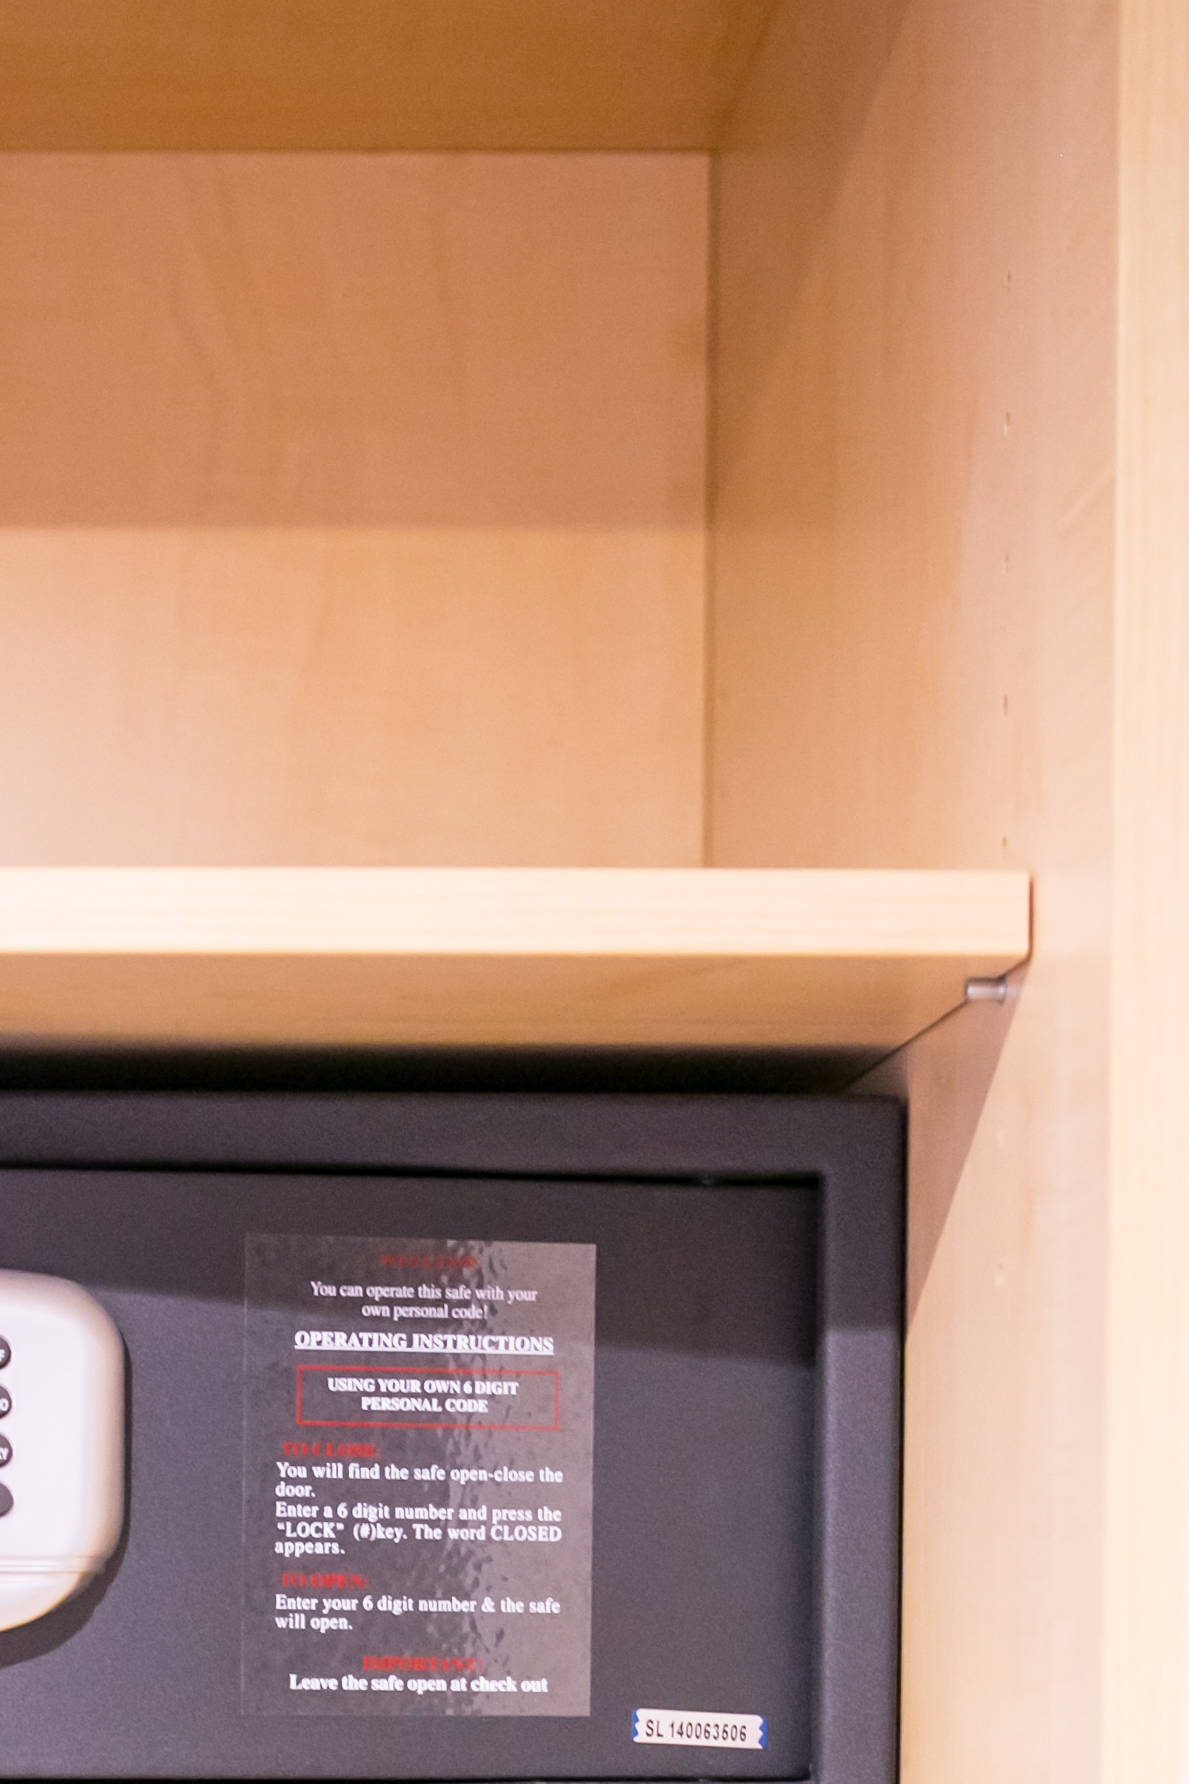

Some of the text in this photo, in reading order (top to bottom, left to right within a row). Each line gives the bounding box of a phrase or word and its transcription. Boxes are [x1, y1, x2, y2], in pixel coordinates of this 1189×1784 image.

[311, 1281, 537, 1304] You can operate this safe with your
[362, 1304, 488, 1320] own personal code!
[295, 1331, 554, 1354] OPERATING INSTRUCTIONS
[328, 1378, 518, 1395] USING YOUR OWN 6 DIGIT
[362, 1398, 488, 1412] PERSONAL CODE
[282, 1442, 307, 1457] TO
[276, 1462, 563, 1484] You will find the safe open-close the
[275, 1481, 316, 1497] door.
[276, 1502, 561, 1524] Enter a 6 digit number and press the
[413, 1523, 442, 1540] The
[447, 1525, 486, 1541] word
[491, 1525, 562, 1541] CLOSED
[275, 1542, 345, 1557] appears.
[281, 1573, 307, 1587] TO
[276, 1594, 561, 1615] Enter your 6 digit number & the safe
[276, 1614, 352, 1633] will open.
[289, 1674, 548, 1694] Leave the safe open at check out
[646, 1720, 663, 1737] SL
